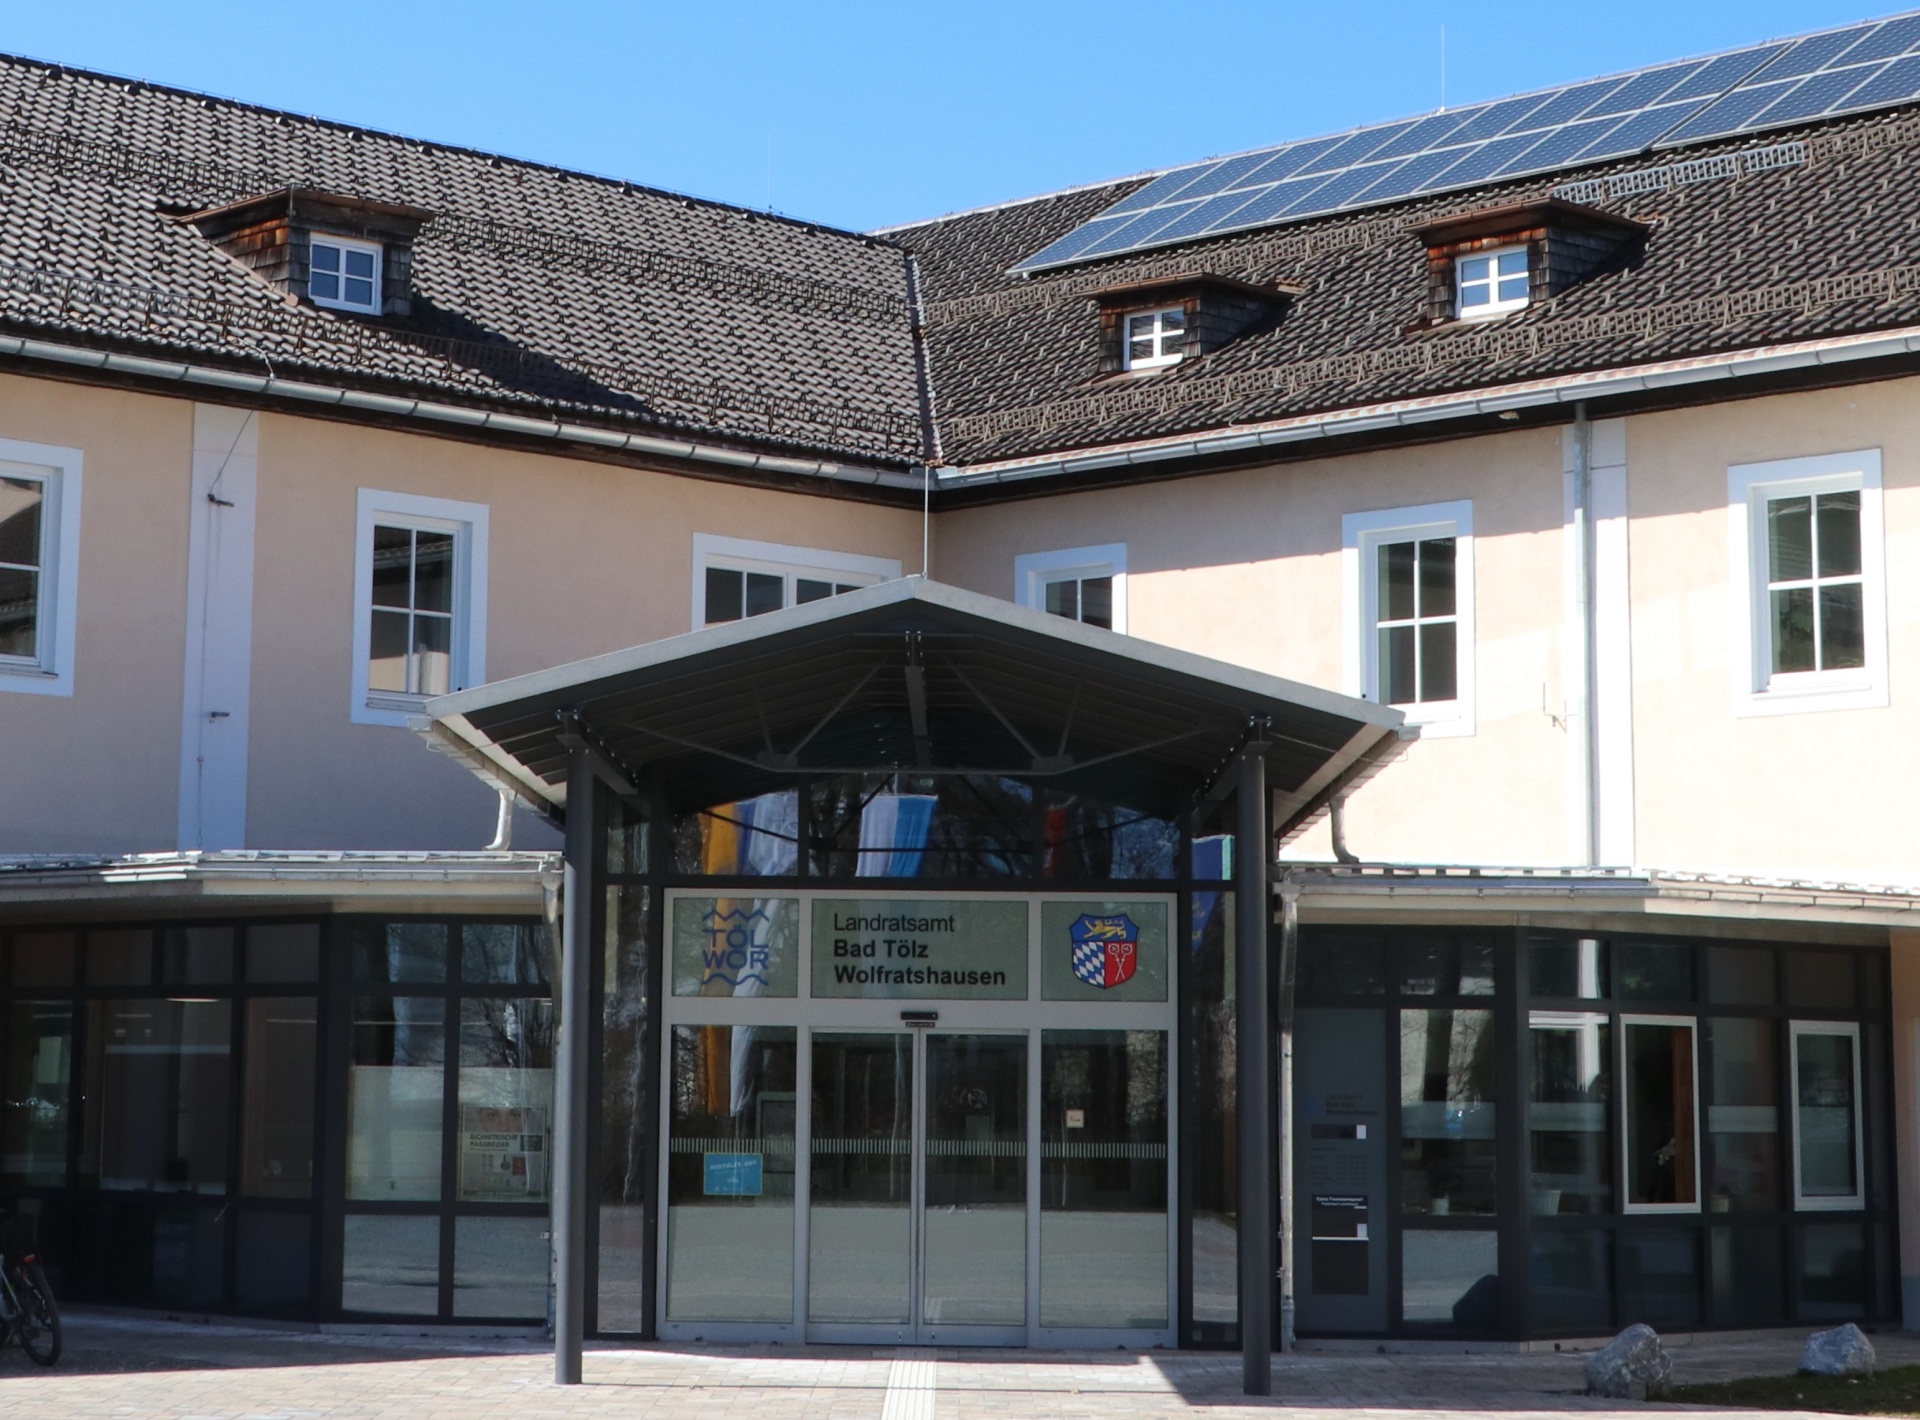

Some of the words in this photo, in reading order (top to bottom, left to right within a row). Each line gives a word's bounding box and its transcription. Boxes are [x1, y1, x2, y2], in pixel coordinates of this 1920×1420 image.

[833, 912, 954, 933] Landratsamt
[702, 923, 769, 949] TÖL
[833, 938, 876, 958] Bad
[882, 938, 928, 958] Tölz
[702, 949, 770, 970] WOR
[833, 964, 1005, 985] Wolfratshausen
